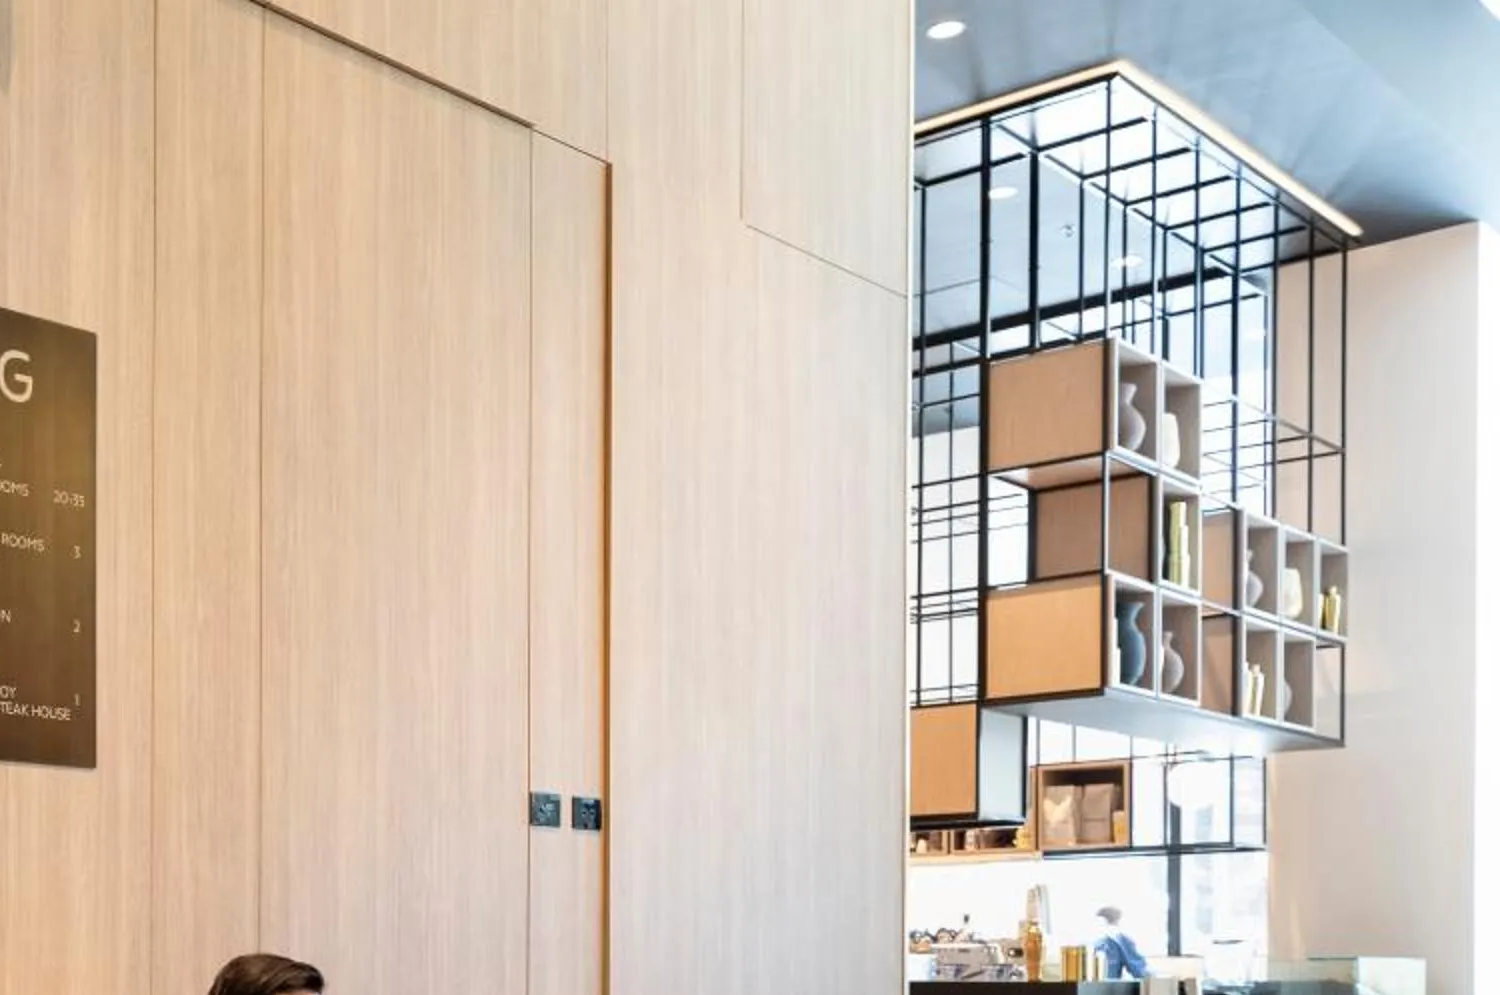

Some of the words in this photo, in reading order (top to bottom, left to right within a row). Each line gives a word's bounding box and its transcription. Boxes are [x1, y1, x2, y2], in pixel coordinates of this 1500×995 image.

[1, 533, 45, 552] ROOMS
[73, 545, 81, 559] 3
[73, 621, 81, 633] 2
[74, 694, 80, 706] 1
[31, 705, 71, 721] HOUSE
